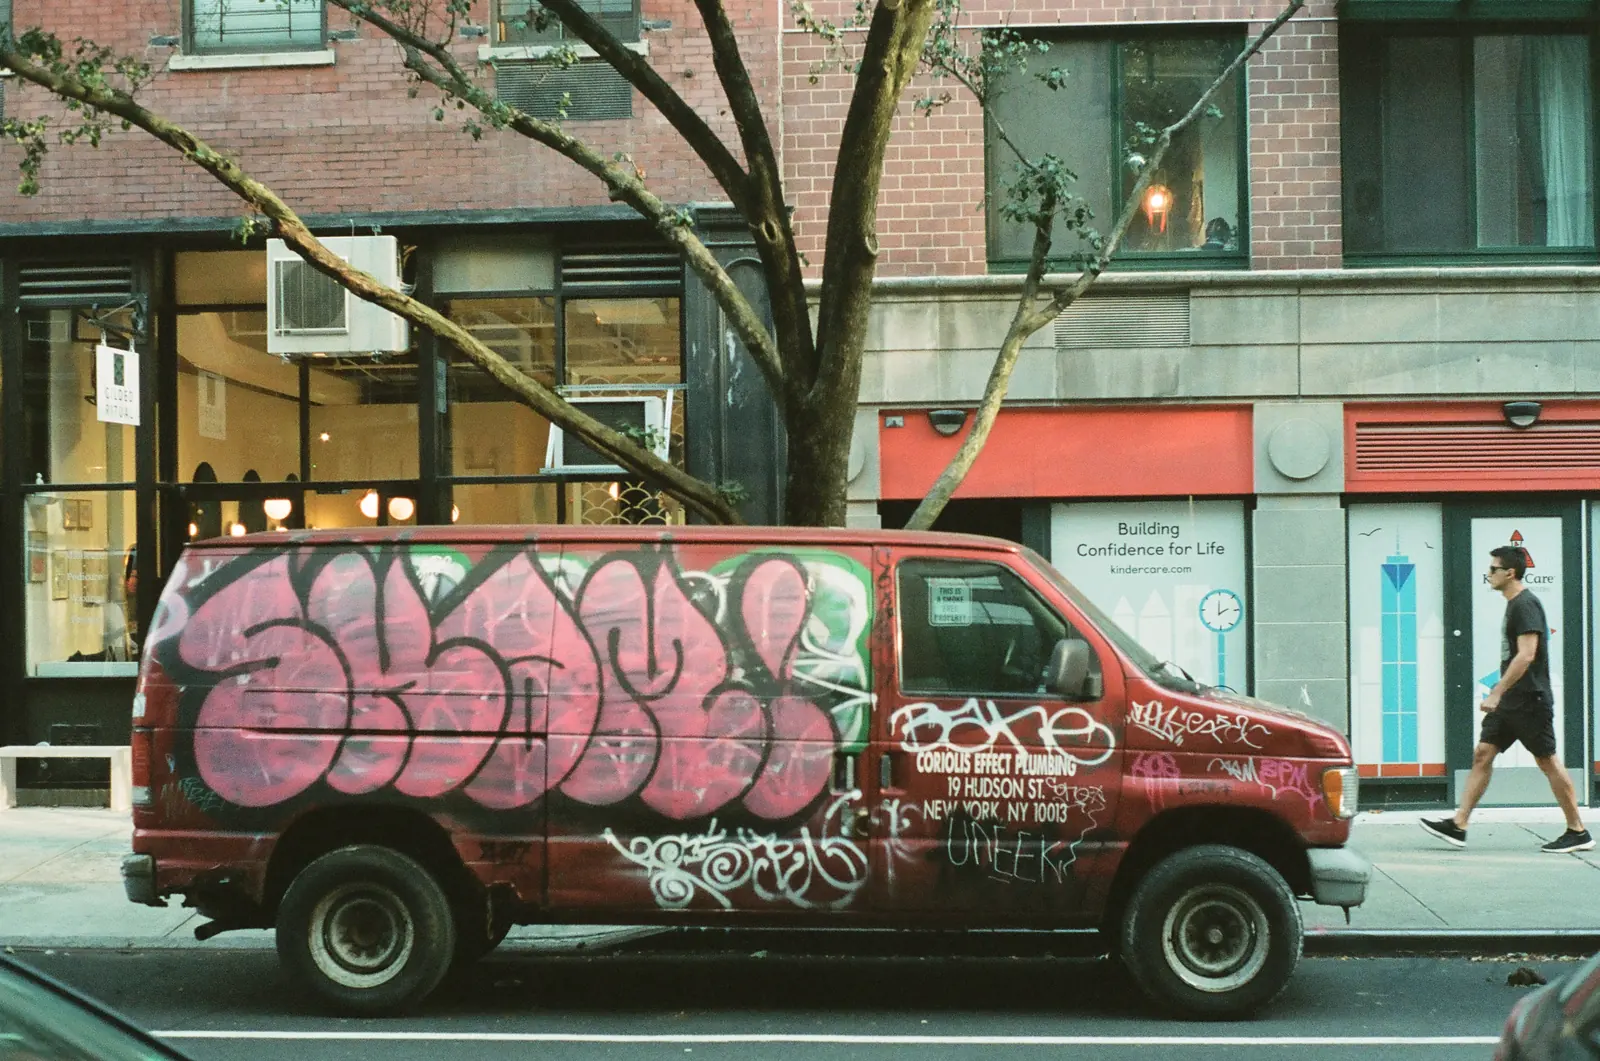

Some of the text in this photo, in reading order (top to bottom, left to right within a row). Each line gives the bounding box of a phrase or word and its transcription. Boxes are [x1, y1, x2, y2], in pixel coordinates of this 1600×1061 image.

[1118, 522, 1180, 538] Building
[1077, 542, 1225, 557] Confidence for Life
[1110, 565, 1192, 574] kindercare.com
[1482, 573, 1554, 584] KCare
[939, 587, 962, 595] THIS IS
[916, 751, 1077, 776] CORIOLIS EFFECT PLUMBING
[948, 776, 961, 797] 19
[964, 777, 1024, 799] HUDSON
[1027, 778, 1046, 799] ST.
[923, 800, 958, 820] NEW
[1007, 802, 1029, 822] NY
[1033, 802, 1068, 823] 10013
